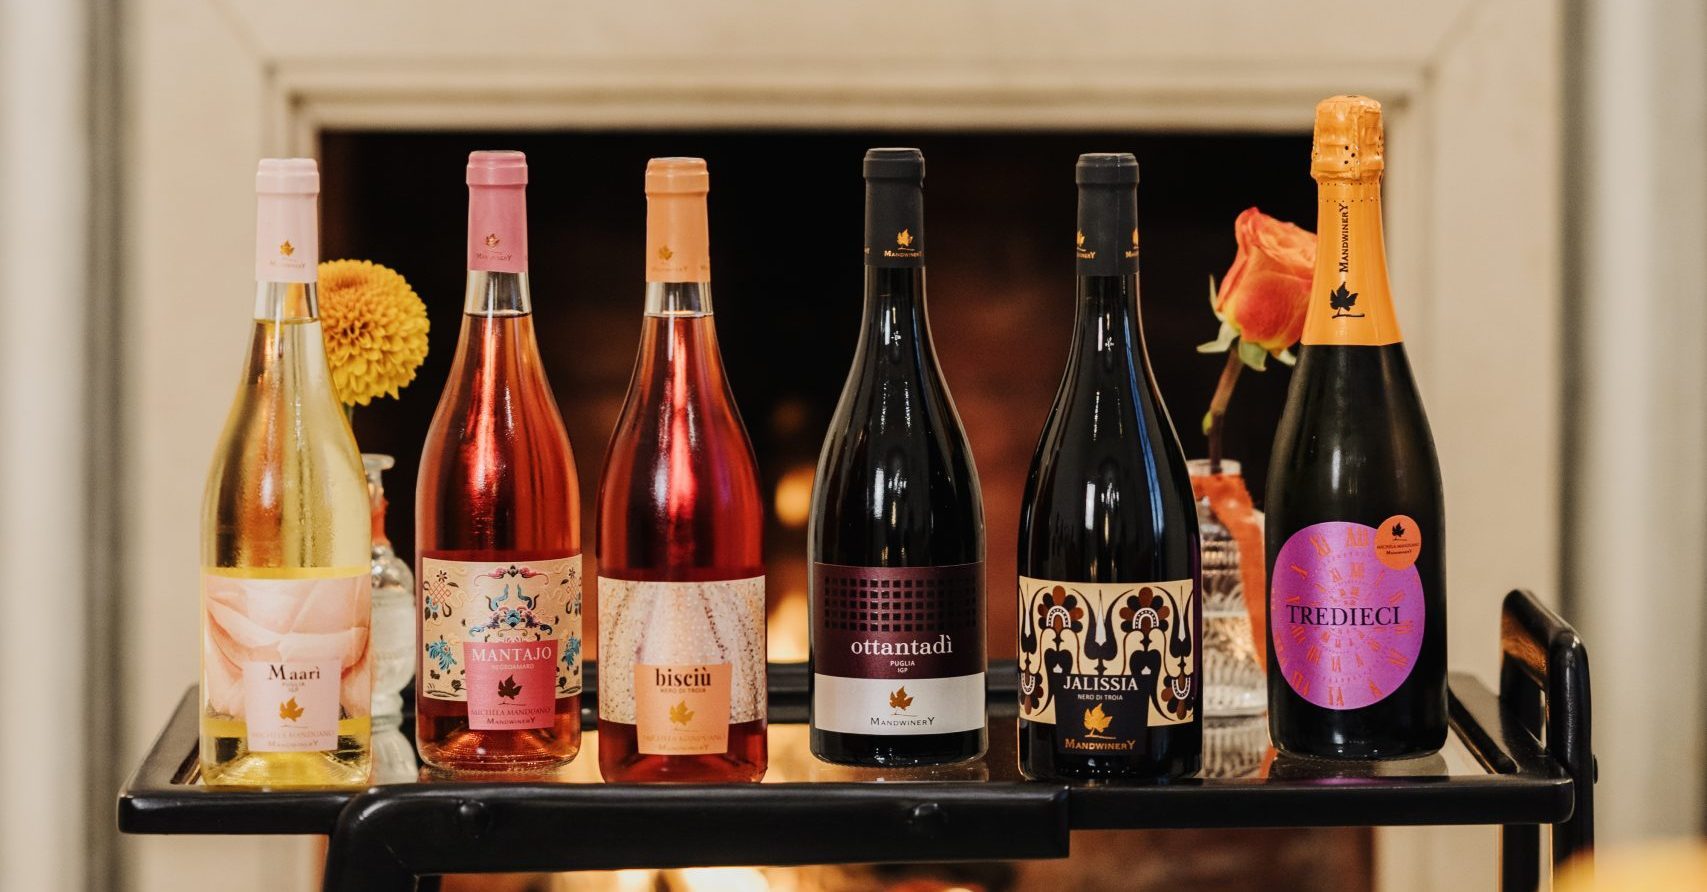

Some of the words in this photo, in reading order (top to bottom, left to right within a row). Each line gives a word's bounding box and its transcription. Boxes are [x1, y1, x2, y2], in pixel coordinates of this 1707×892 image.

[1286, 604, 1401, 626] TREDIECI
[471, 646, 552, 662] MANTAJO
[851, 634, 953, 656] ottantadì
[268, 664, 320, 681] Maarì
[656, 666, 711, 687] bisciù
[1063, 675, 1139, 691] JALISSIA
